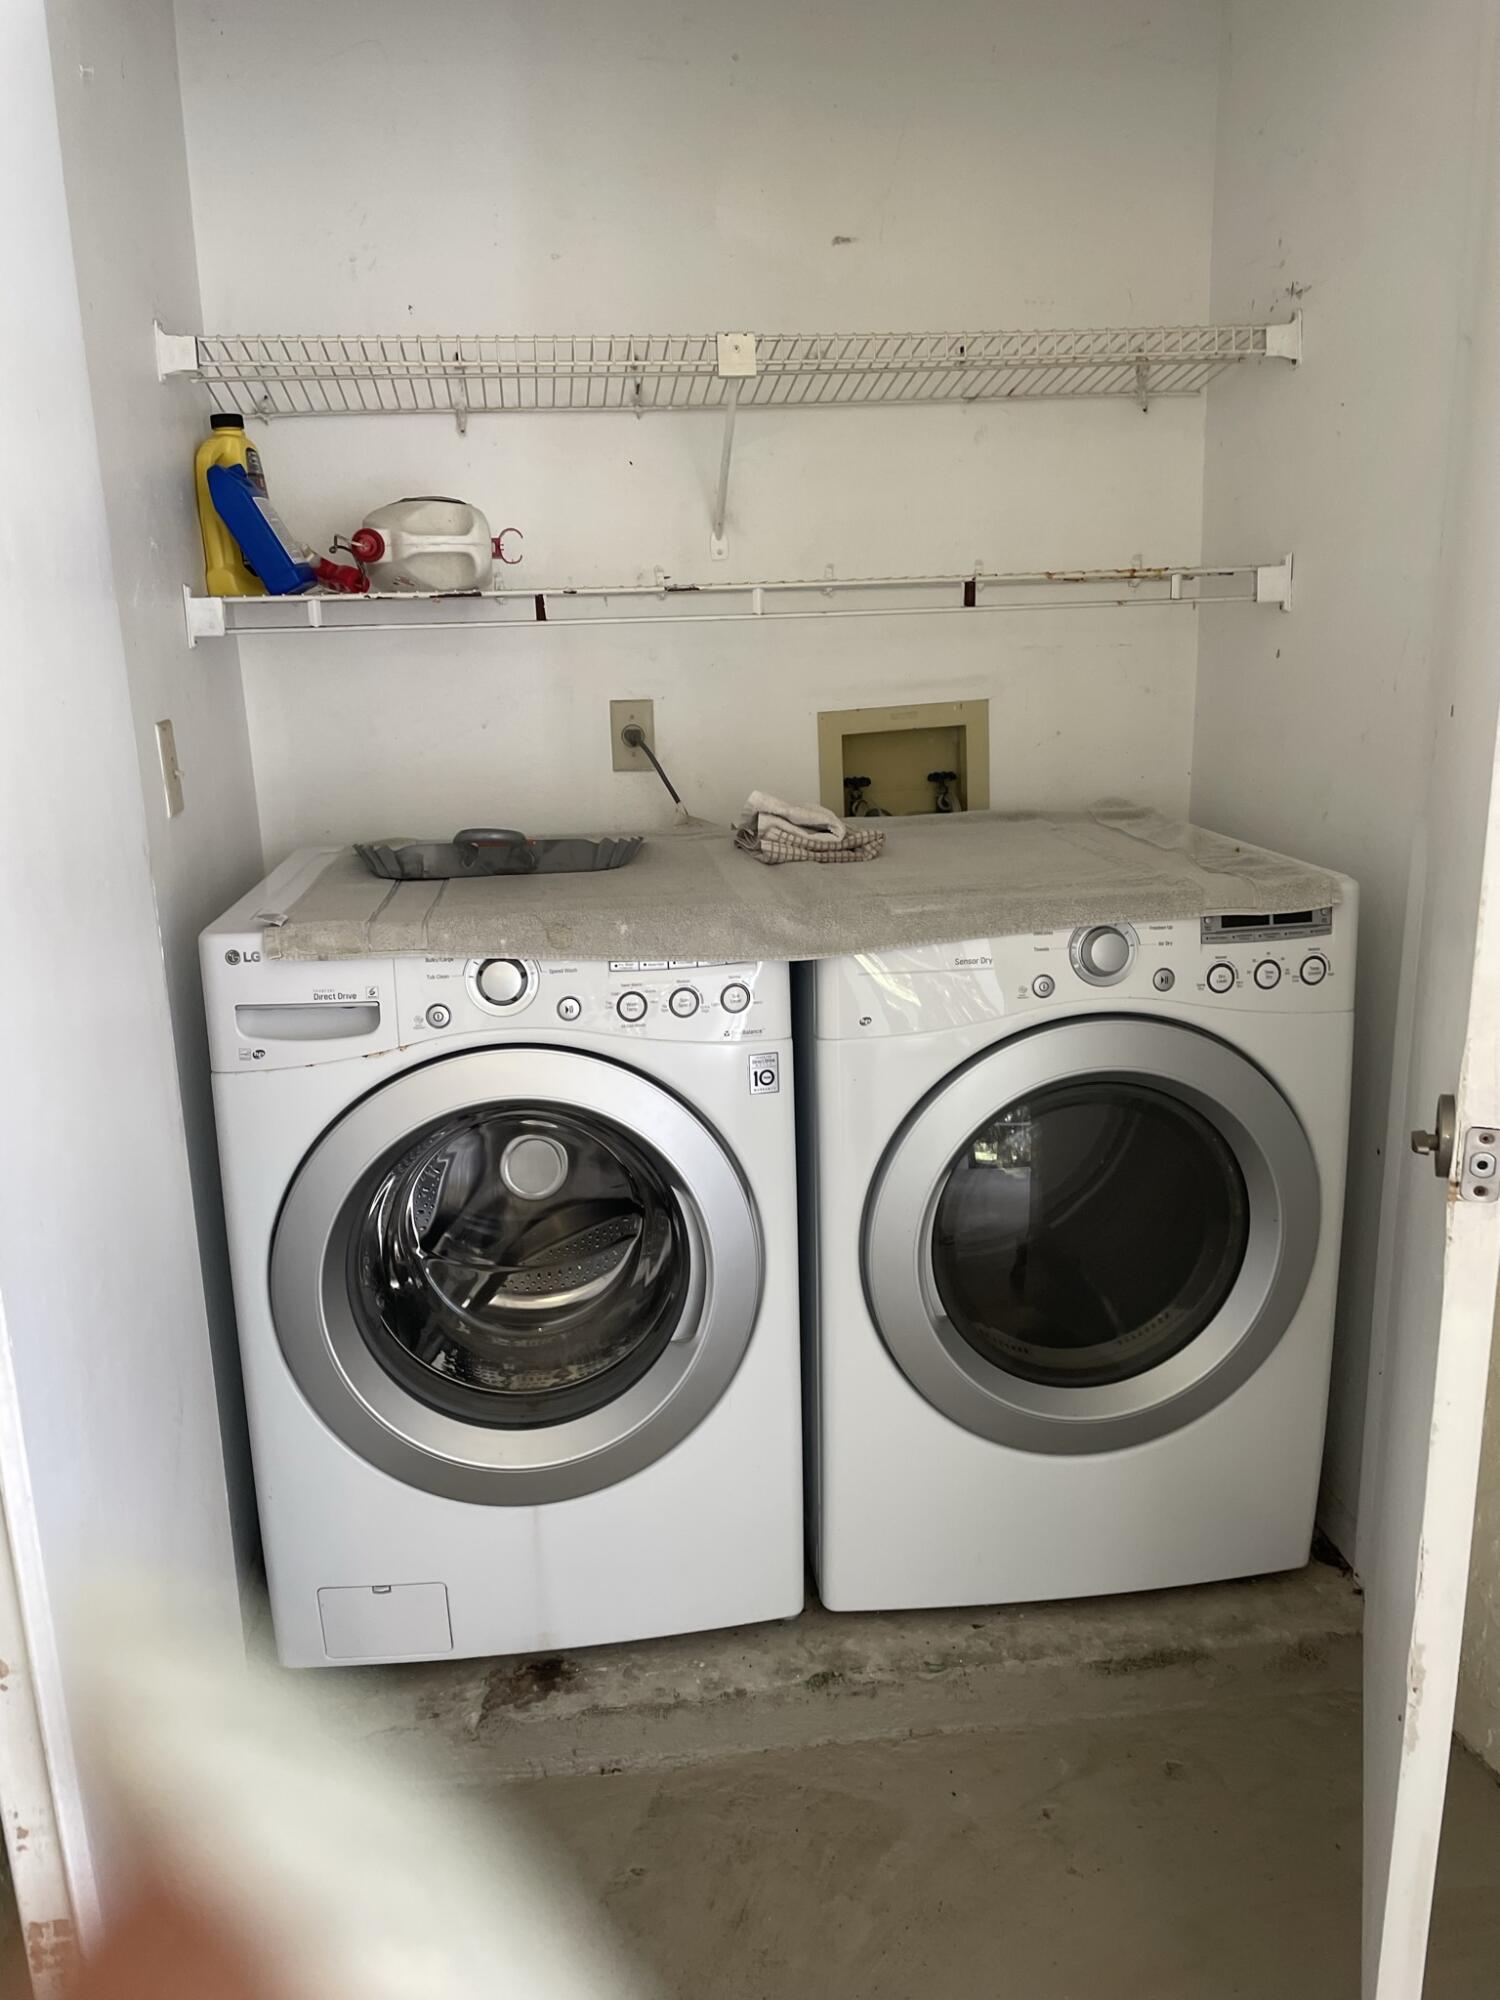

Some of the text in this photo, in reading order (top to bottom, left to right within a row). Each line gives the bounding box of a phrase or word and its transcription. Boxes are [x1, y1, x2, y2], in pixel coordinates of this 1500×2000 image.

[242, 951, 261, 962] LG
[954, 956, 993, 966] Sensor Dry
[313, 992, 358, 1001] Direct Drive
[753, 1068, 776, 1087] 10
